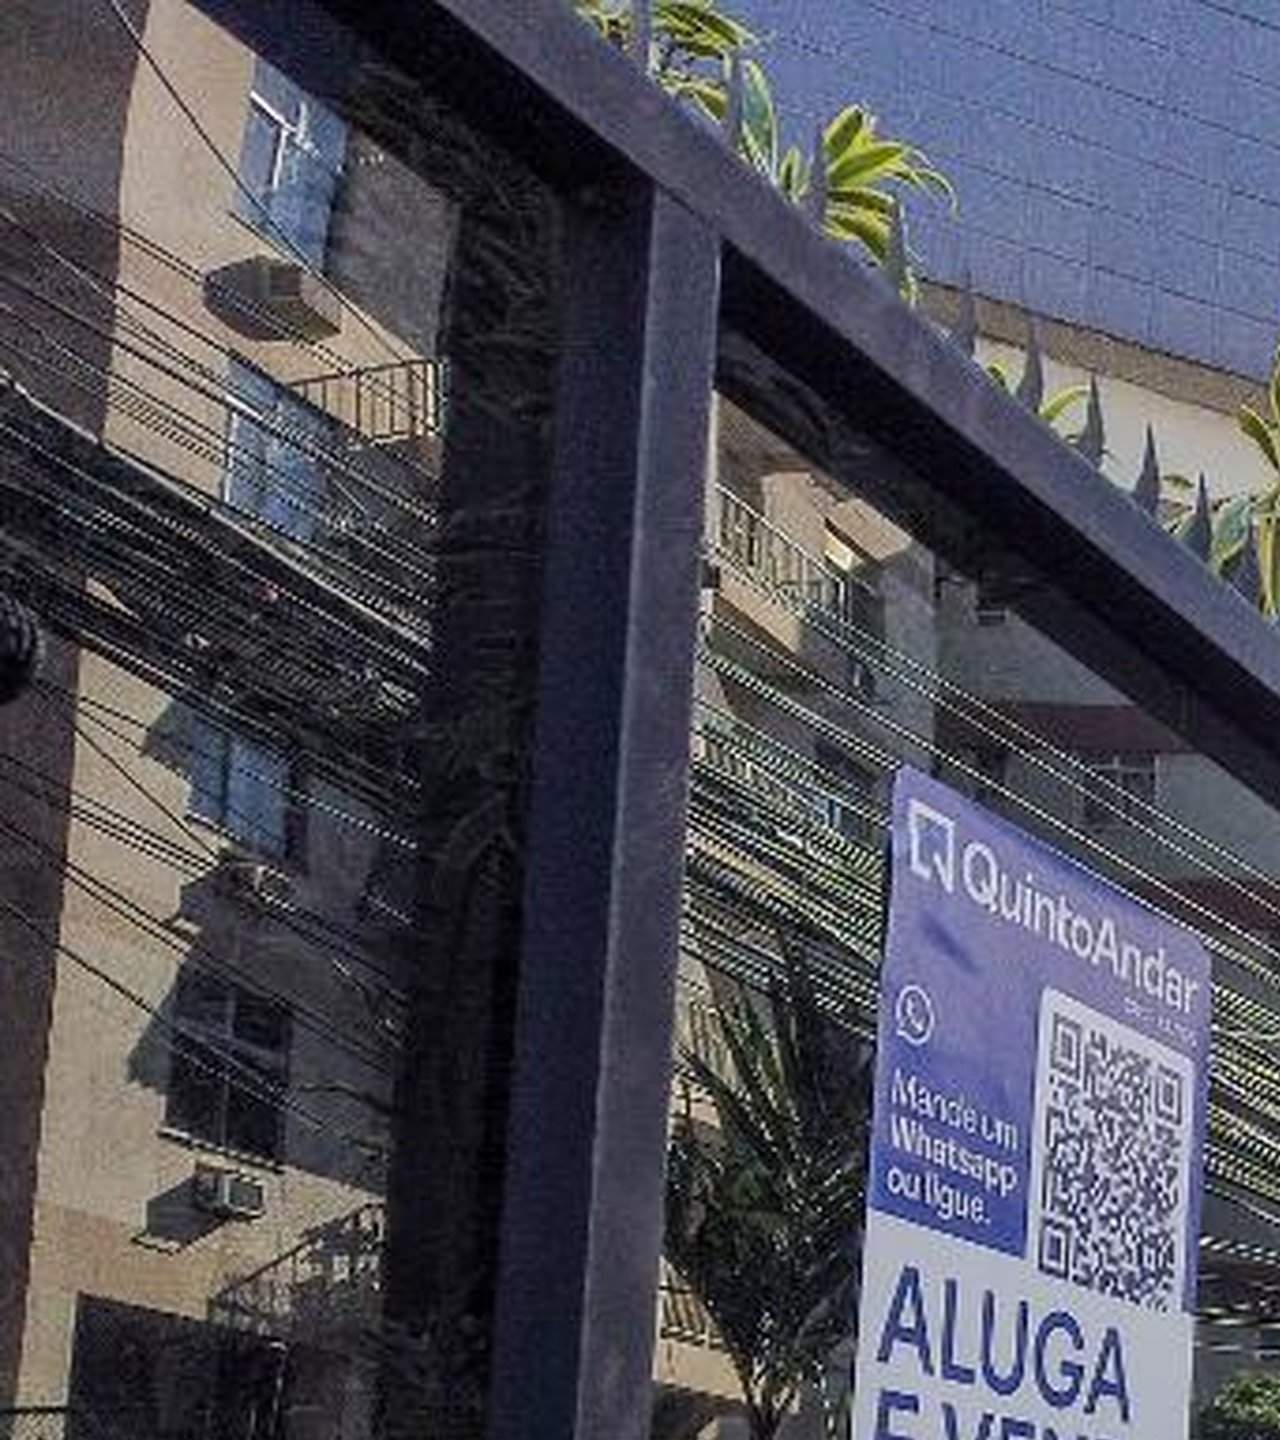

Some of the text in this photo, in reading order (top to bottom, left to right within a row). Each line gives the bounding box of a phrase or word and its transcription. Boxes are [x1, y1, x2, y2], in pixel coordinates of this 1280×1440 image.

[962, 841, 1199, 1013] QuintoAndar
[891, 1067, 976, 1133] Mande
[887, 1166, 921, 1200] ou
[890, 1113, 1018, 1198] Whatsapp
[876, 1266, 1131, 1422] ALUGA
